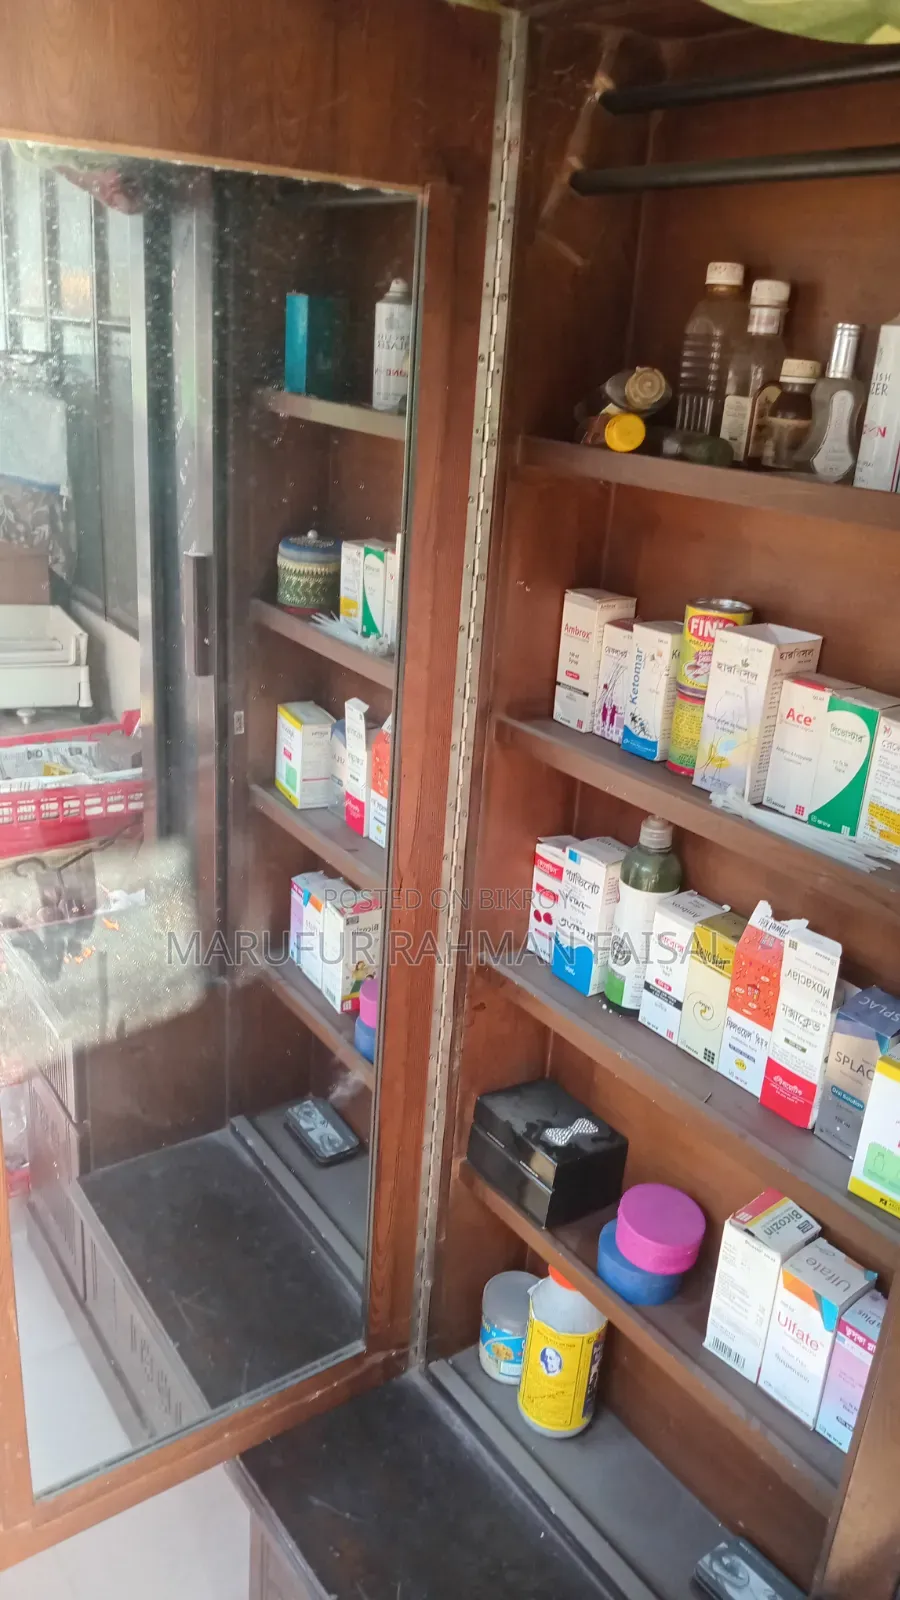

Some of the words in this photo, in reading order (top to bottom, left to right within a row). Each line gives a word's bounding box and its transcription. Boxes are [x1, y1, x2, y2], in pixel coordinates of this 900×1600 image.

[565, 623, 590, 639] Ambrox
[630, 647, 643, 704] Ketomar
[786, 708, 812, 726] Ace
[786, 969, 831, 1000] Moxaclav
[858, 996, 900, 1022] SPLAC
[835, 1051, 874, 1081] SPLAC
[842, 1092, 863, 1109] Solution
[764, 1209, 803, 1237] Bicozin
[805, 1256, 851, 1293] Ulfate
[777, 1311, 820, 1352] Ulfate
